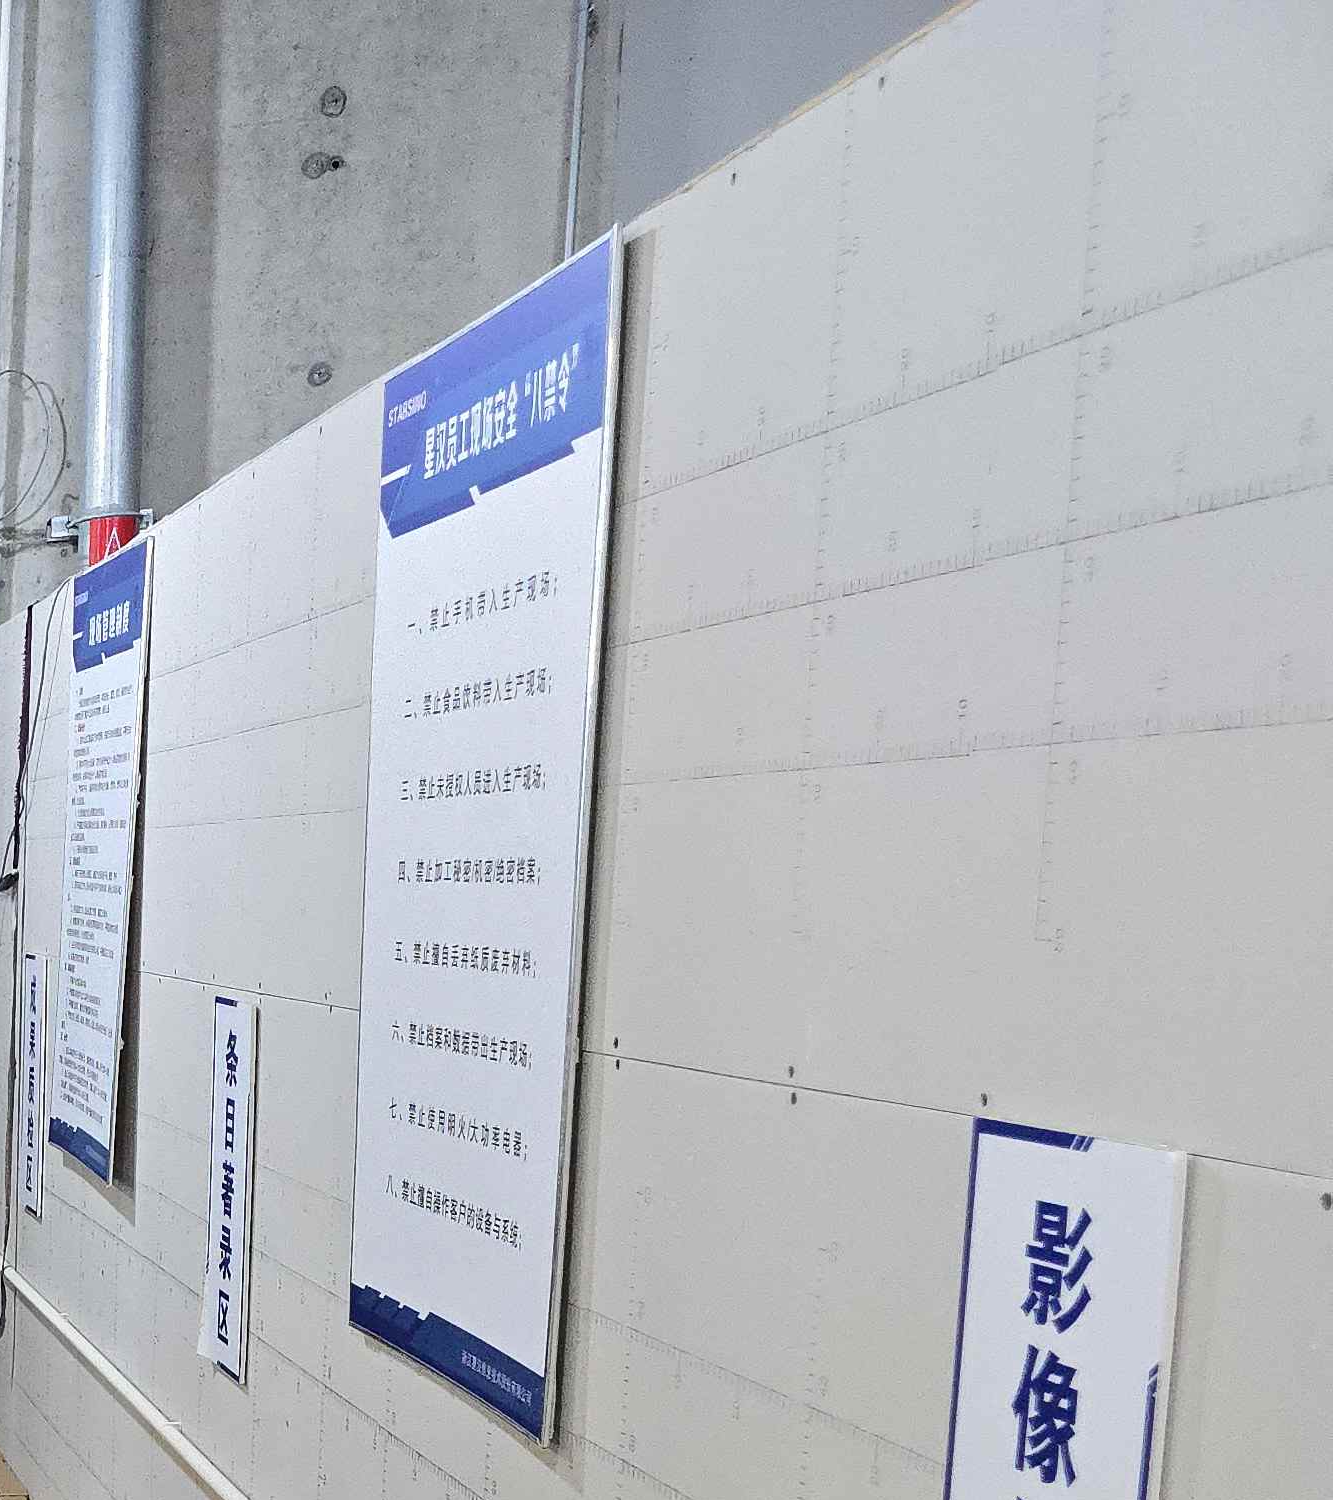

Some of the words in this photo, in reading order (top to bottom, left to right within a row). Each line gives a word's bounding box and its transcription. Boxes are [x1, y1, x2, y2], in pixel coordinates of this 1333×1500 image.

[217, 1029, 238, 1345] 条目著录区
